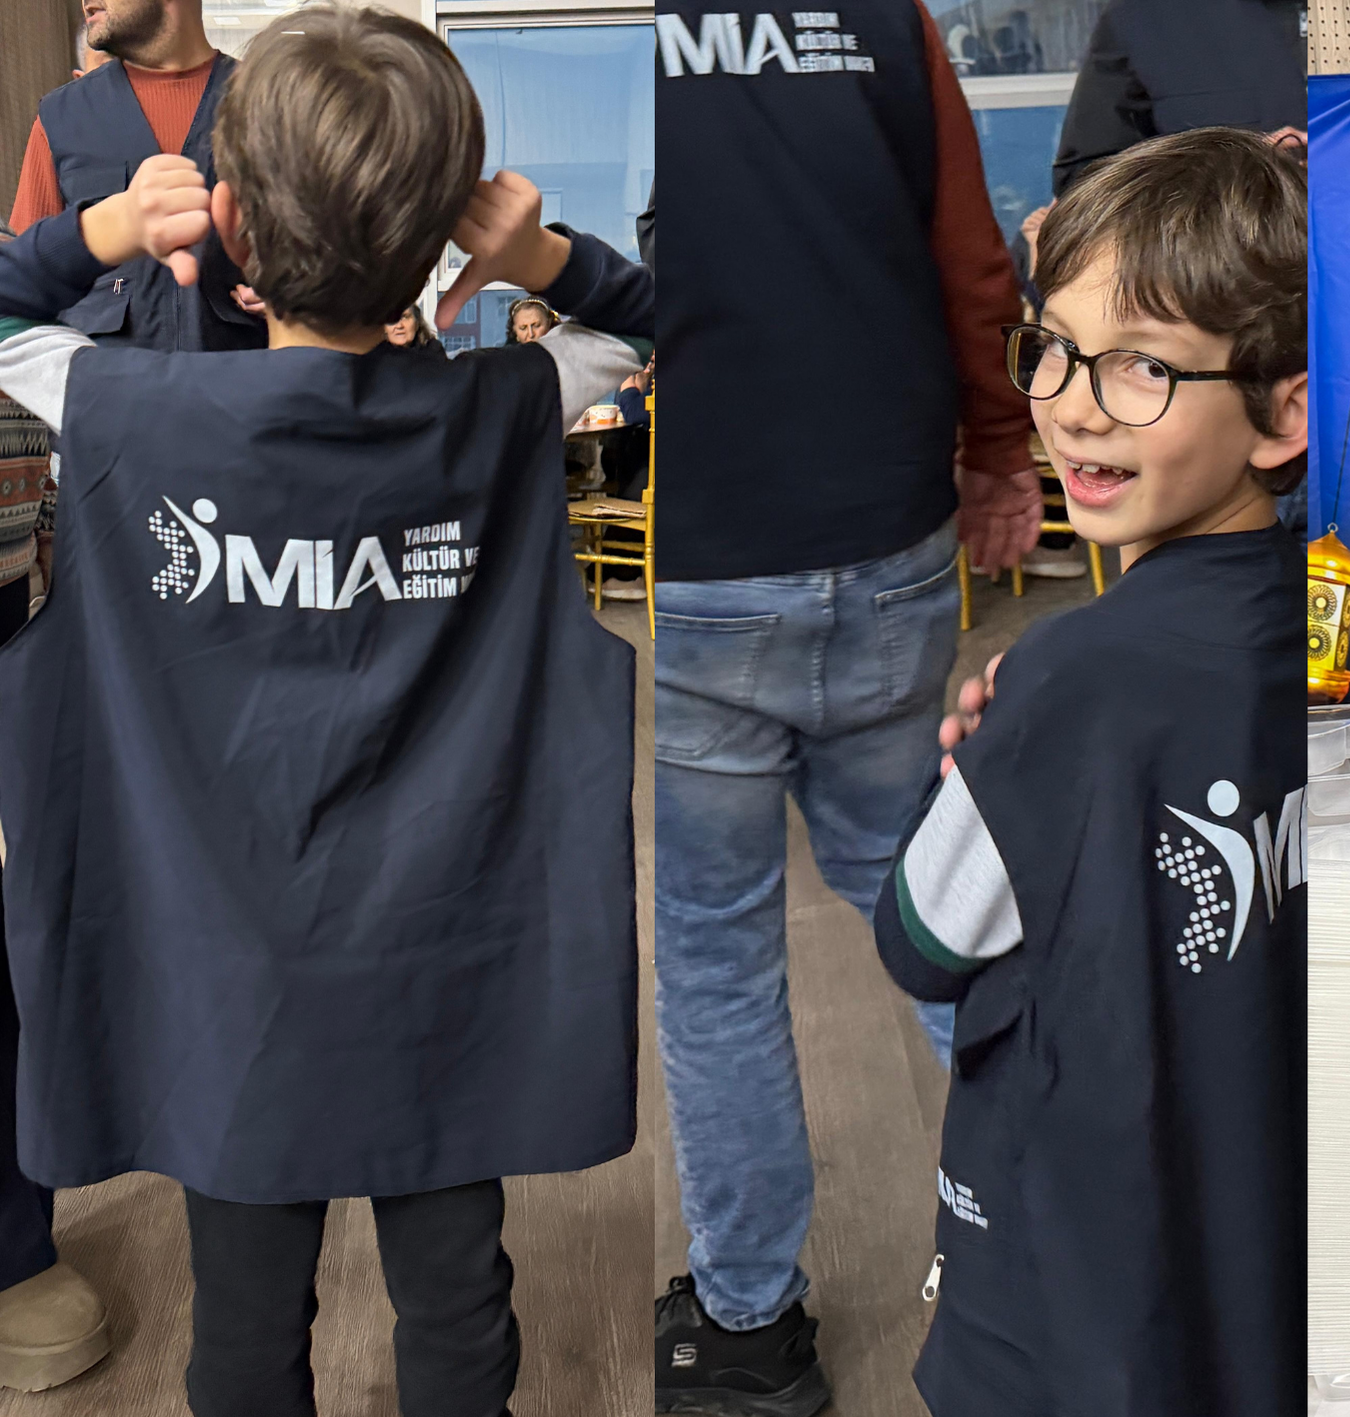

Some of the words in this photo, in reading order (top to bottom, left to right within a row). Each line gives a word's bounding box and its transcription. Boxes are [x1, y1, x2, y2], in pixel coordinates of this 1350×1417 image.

[403, 520, 461, 547] YARDIM
[402, 545, 460, 572] KÜLTÜR
[403, 574, 457, 599] EĞİTİM
